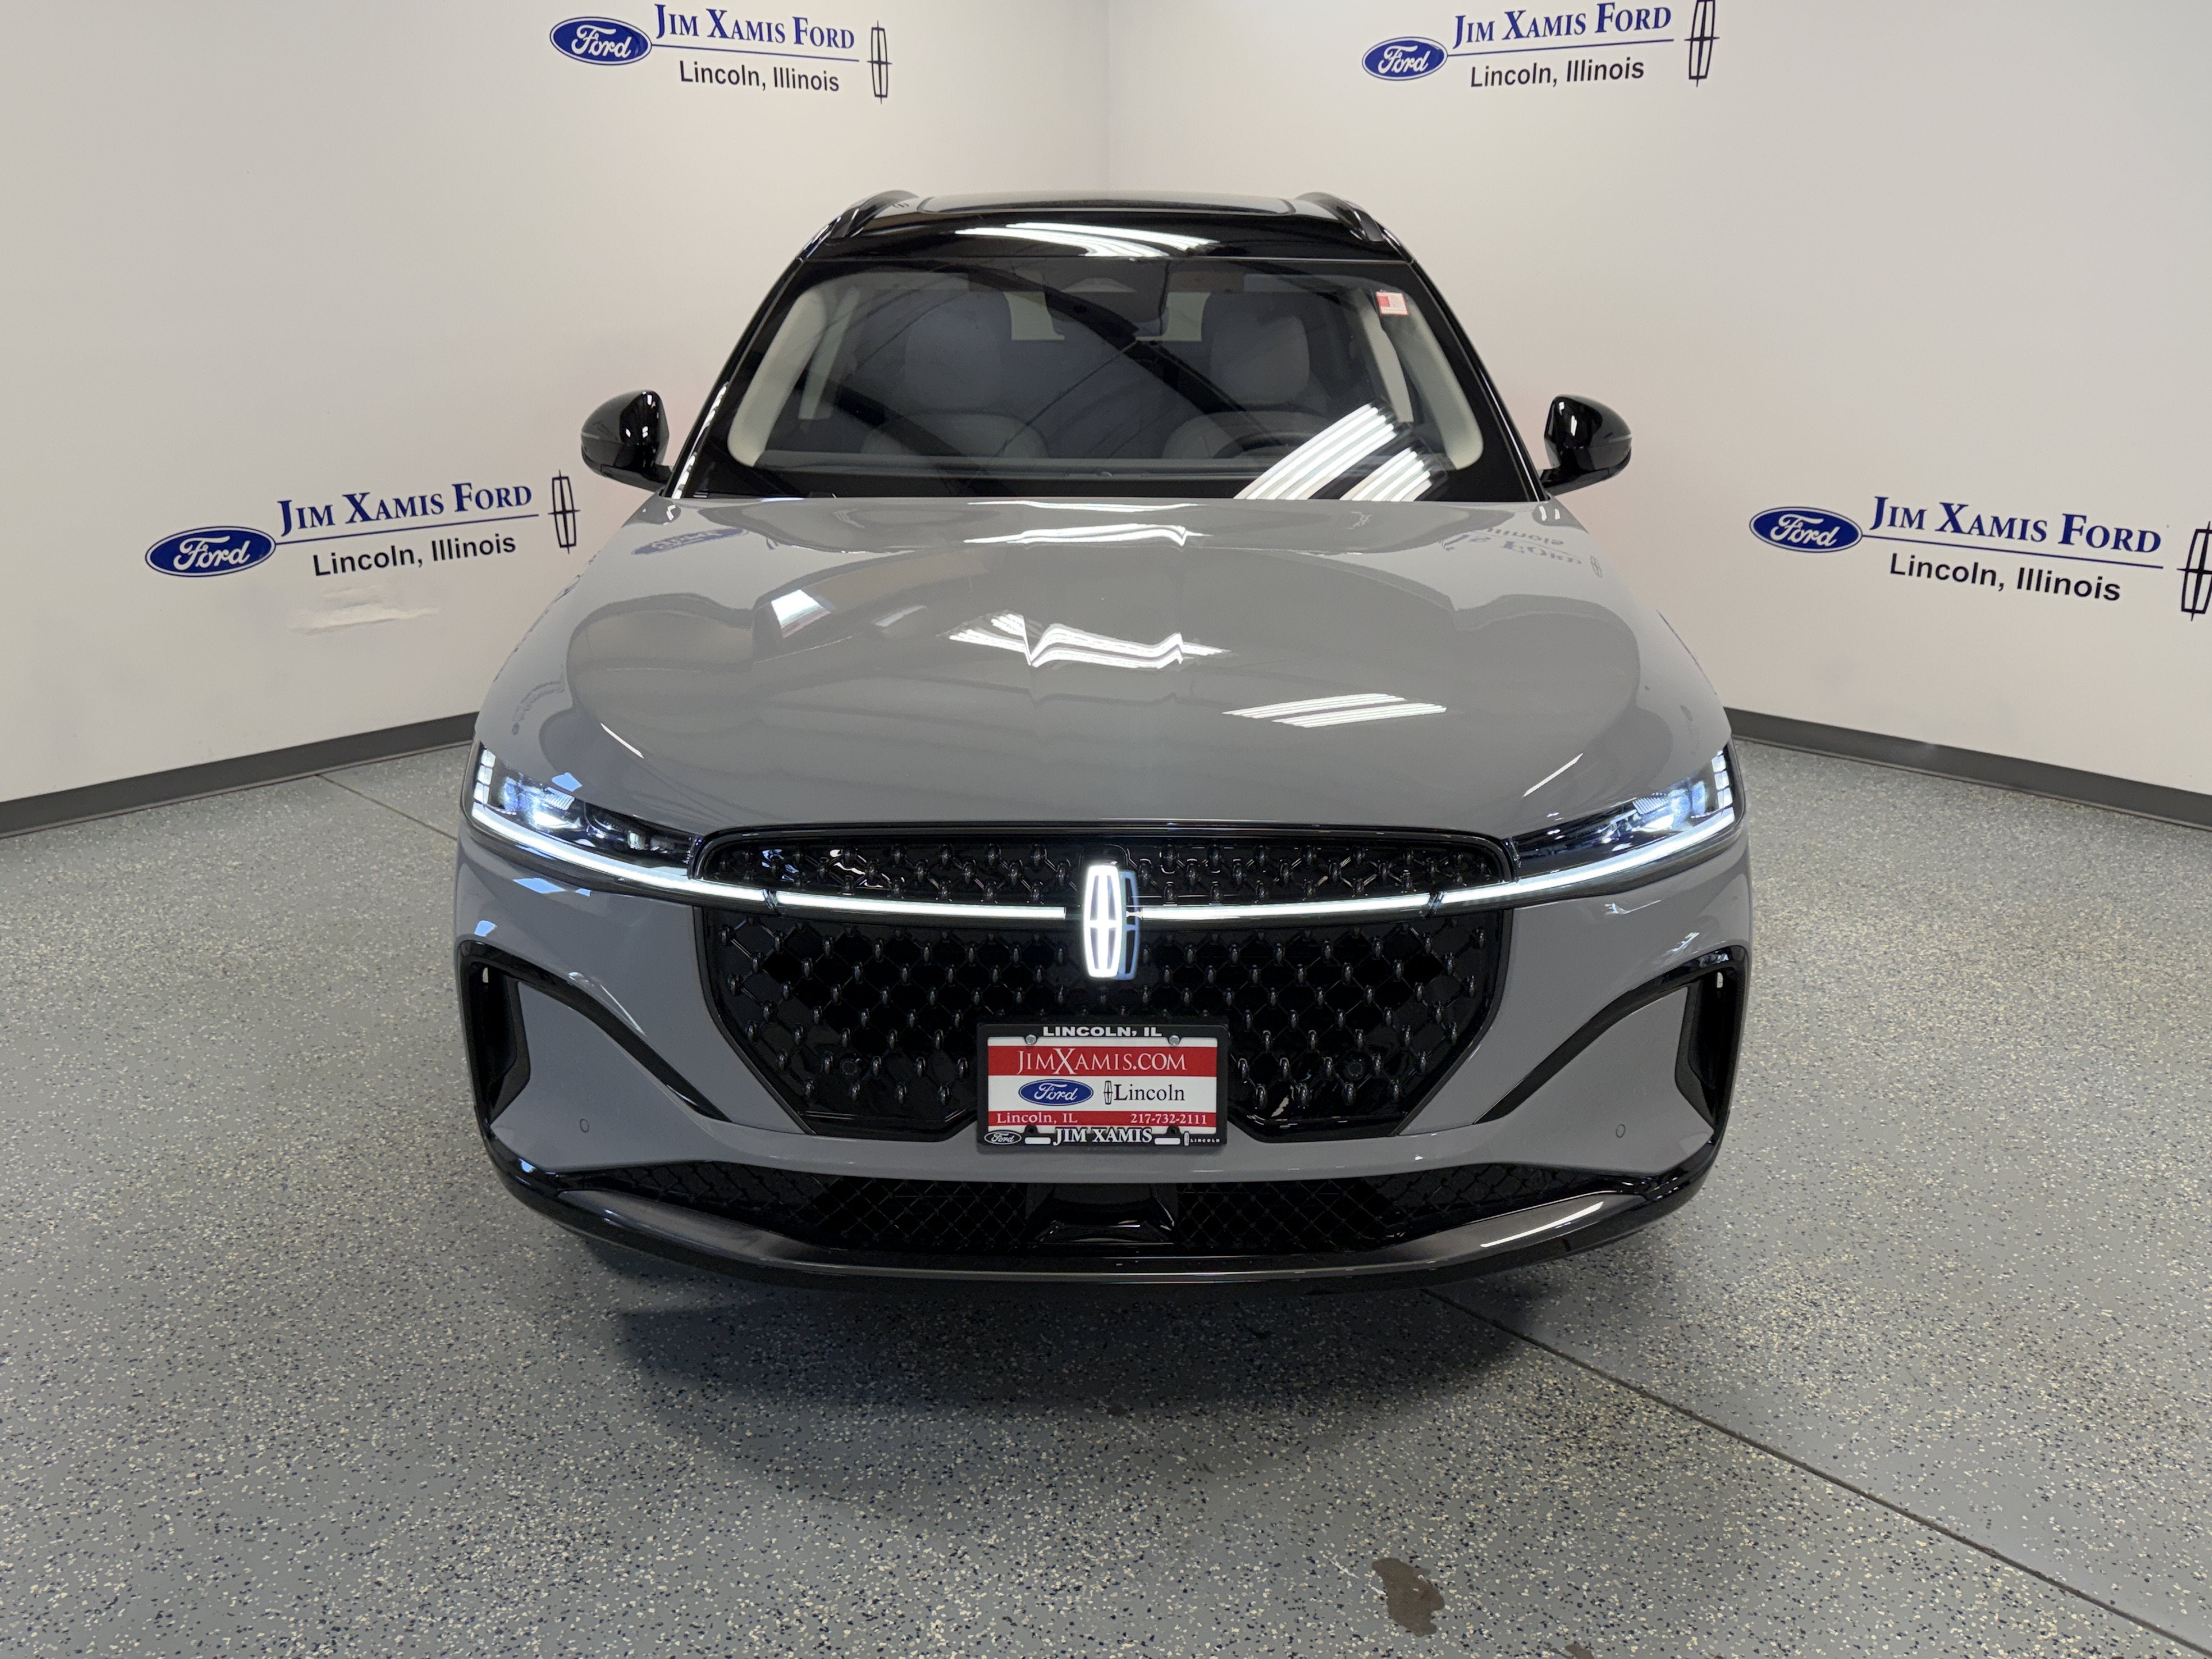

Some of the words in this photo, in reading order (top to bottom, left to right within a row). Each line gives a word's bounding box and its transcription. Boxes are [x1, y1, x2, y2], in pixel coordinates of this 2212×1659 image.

[654, 3, 698, 40] JIM
[706, 8, 786, 43] XAMIS
[792, 16, 855, 49] FORD
[1452, 14, 1494, 49] JIM
[1502, 9, 1586, 40] XAMIS
[1594, 2, 1672, 33] FORD
[571, 24, 632, 59] Ford
[1378, 45, 1431, 74] Ford
[1471, 62, 1558, 88] Lincoln,
[1566, 57, 1645, 82] Illinois
[680, 60, 766, 91] Lincoln,
[773, 66, 840, 92] Illinois
[276, 499, 332, 537] JIM
[342, 491, 444, 524] XAMIS
[451, 482, 532, 512] FORD
[1869, 495, 1927, 531] JIM
[1935, 501, 2047, 543] XAMIS
[2058, 513, 2161, 554] FORD
[1770, 513, 1838, 548] Ford
[173, 534, 251, 571] Ford
[313, 545, 423, 577] Lincoln,
[432, 533, 516, 563] Illinois
[1889, 553, 2005, 592] Lincoln,
[2016, 567, 2121, 601] Illinois
[1043, 1026, 1136, 1036] LINCOLN,
[1144, 1027, 1162, 1036] IL
[1017, 1048, 1186, 1075] JIMXAMIS.COM
[1034, 1082, 1077, 1102] Ford
[1114, 1084, 1185, 1101] Lincoln
[997, 1113, 1057, 1124] Lincoln,
[1063, 1113, 1077, 1124] IL
[1131, 1113, 1206, 1125] 217-732-2111
[991, 1133, 1014, 1142] Ford
[1053, 1127, 1087, 1146] JIM
[1092, 1127, 1152, 1143] XAMIS
